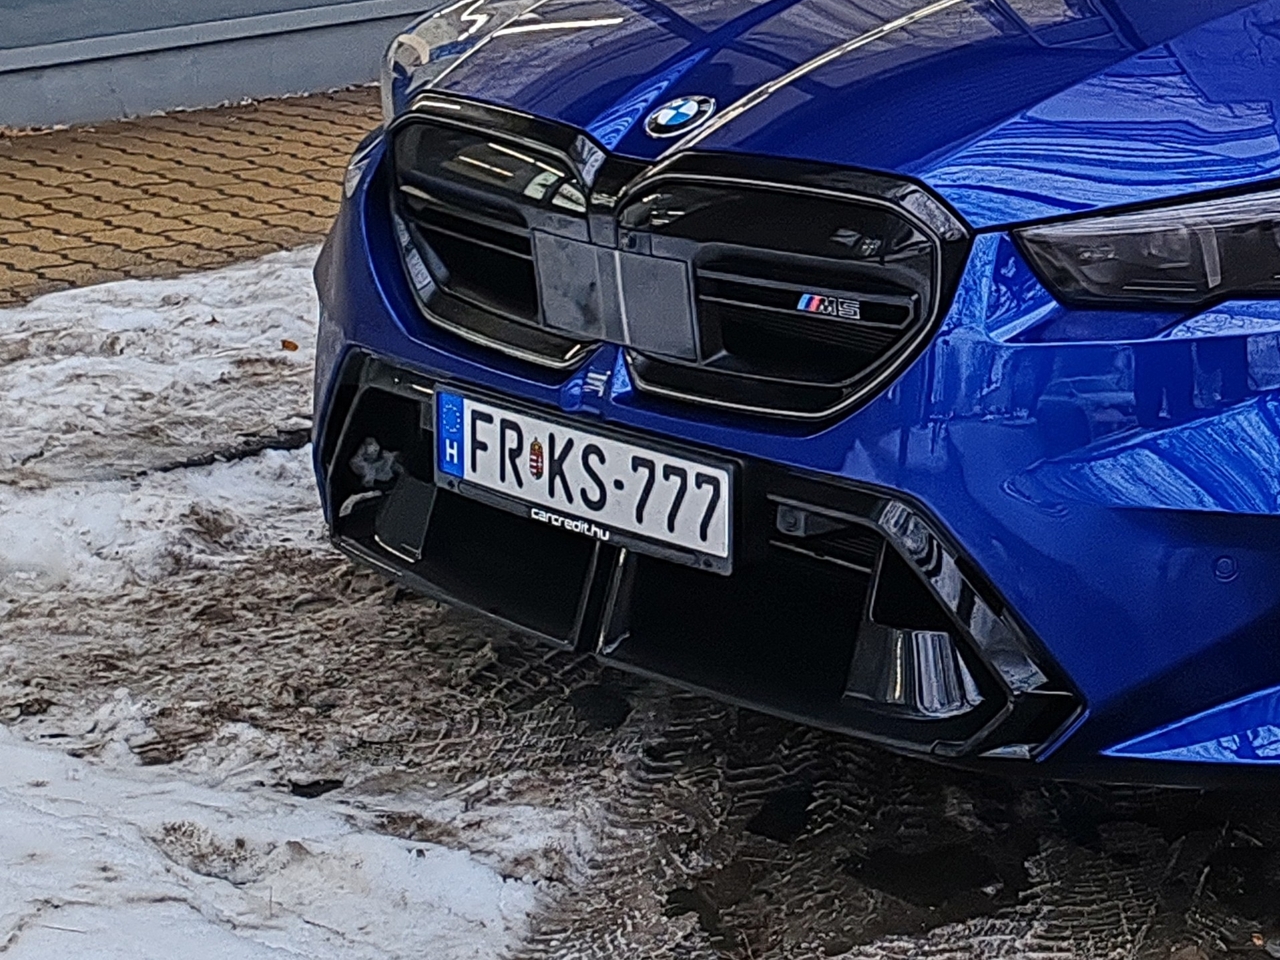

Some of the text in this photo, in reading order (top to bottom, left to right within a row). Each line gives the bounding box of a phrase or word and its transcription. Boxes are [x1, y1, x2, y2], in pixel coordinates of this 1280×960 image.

[818, 296, 860, 319] M5
[445, 439, 458, 465] H
[531, 507, 610, 540] carcredit.hu
